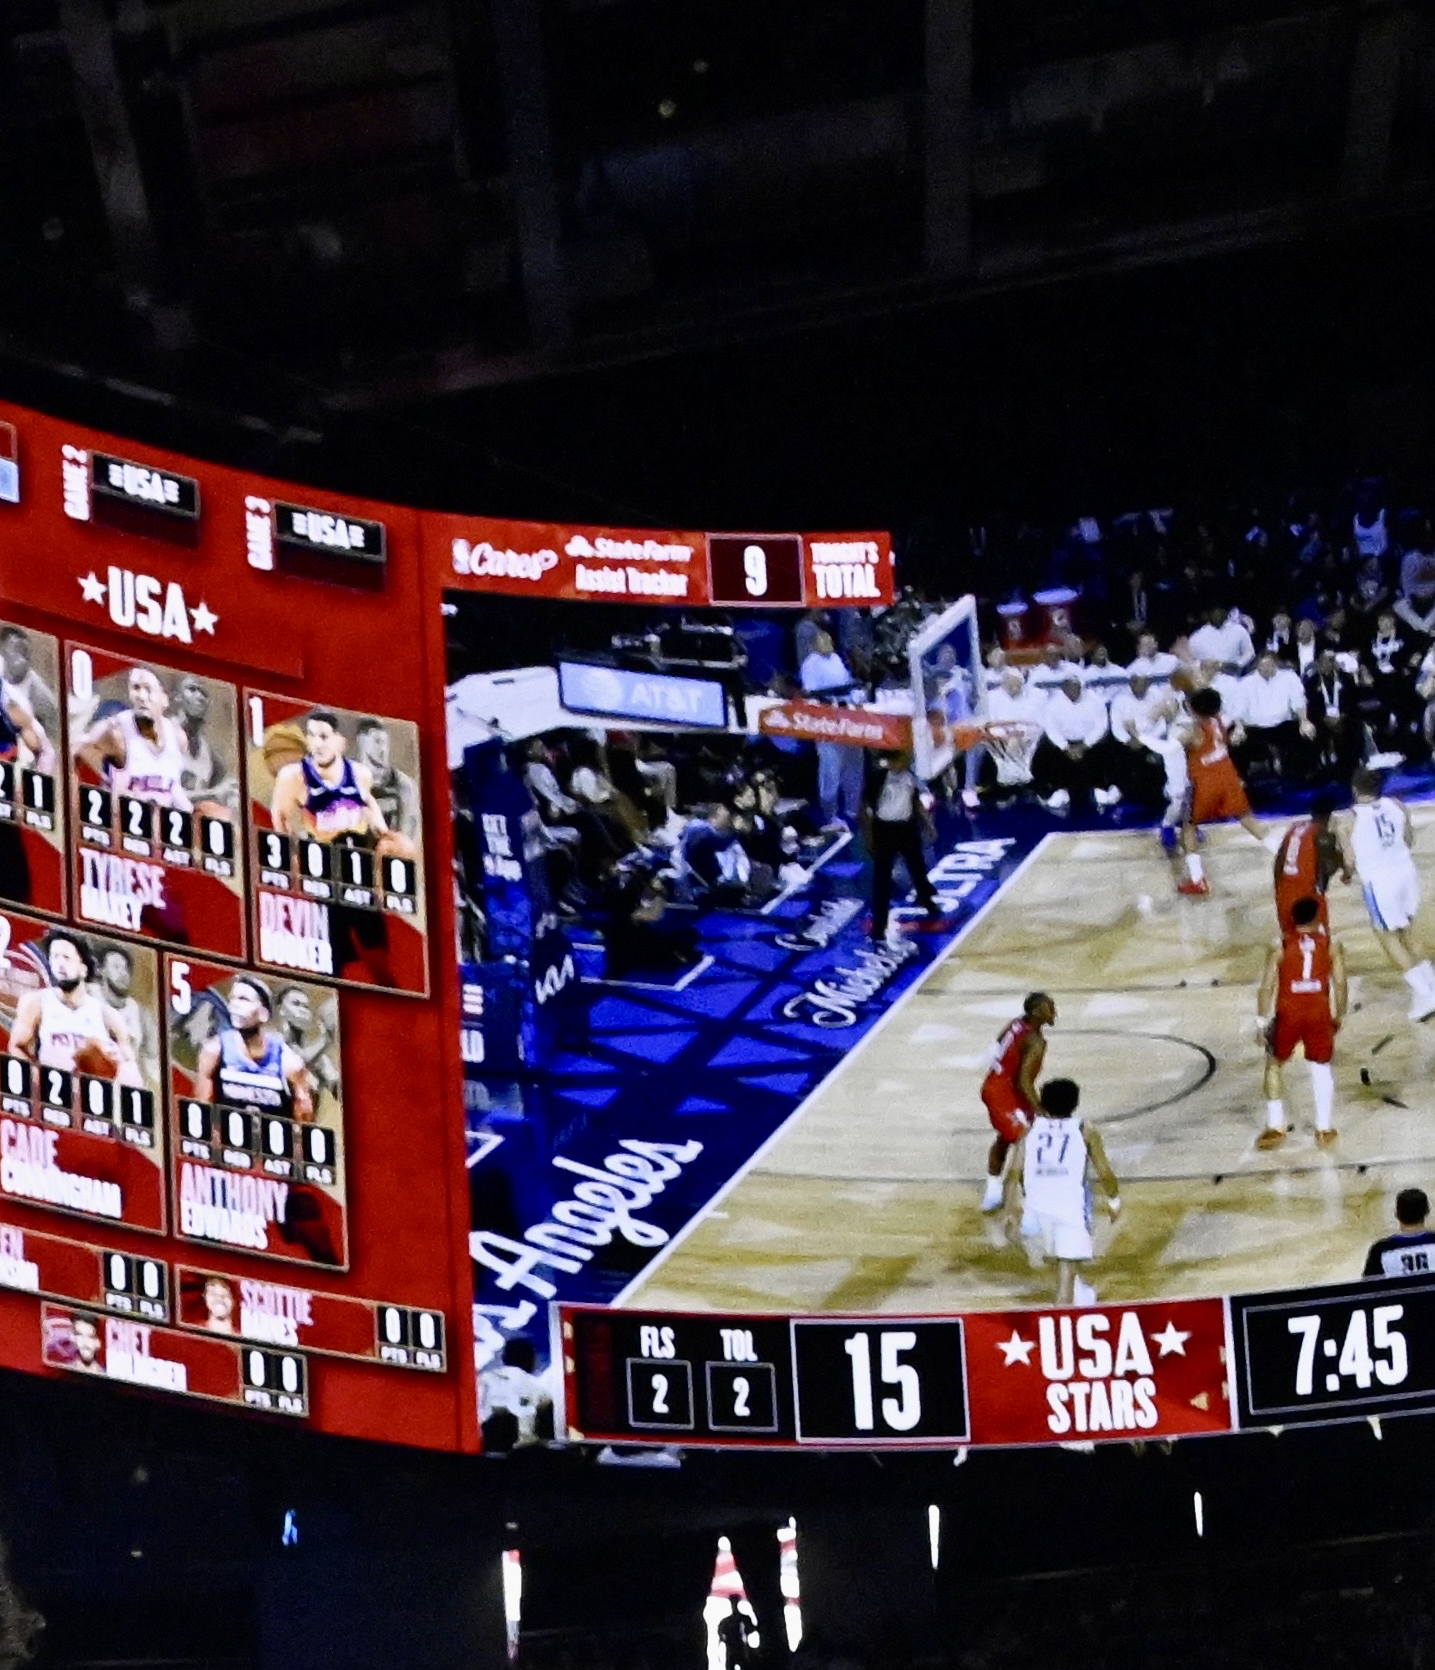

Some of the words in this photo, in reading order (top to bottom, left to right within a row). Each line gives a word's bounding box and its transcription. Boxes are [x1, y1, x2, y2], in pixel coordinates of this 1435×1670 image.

[122, 462, 167, 505] USA
[305, 510, 351, 550] USA
[743, 545, 768, 597] 9
[812, 563, 882, 599] TOTAL
[107, 564, 194, 645] USA
[630, 682, 703, 715] AT&T
[32, 773, 44, 809] 1
[87, 788, 104, 827] 2
[128, 800, 144, 837] 2
[168, 810, 185, 847] 2
[208, 819, 226, 857] 0
[266, 833, 283, 869] 3
[307, 842, 325, 879] 0
[350, 851, 362, 887] 1
[390, 858, 408, 894] 0
[48, 1069, 63, 1106] 2
[131, 1089, 143, 1125] 1
[1036, 1131, 1071, 1164] 27
[180, 1161, 290, 1225] ANTHONY
[468, 1138, 704, 1300] Angeles
[639, 1325, 676, 1359] FLS
[719, 1329, 759, 1362] TOL
[1038, 1311, 1154, 1381] USA
[1287, 1304, 1410, 1396] 7:45
[651, 1373, 670, 1414] 2
[732, 1376, 751, 1417] 2
[844, 1331, 922, 1431] 15
[1046, 1378, 1159, 1434] STARS
